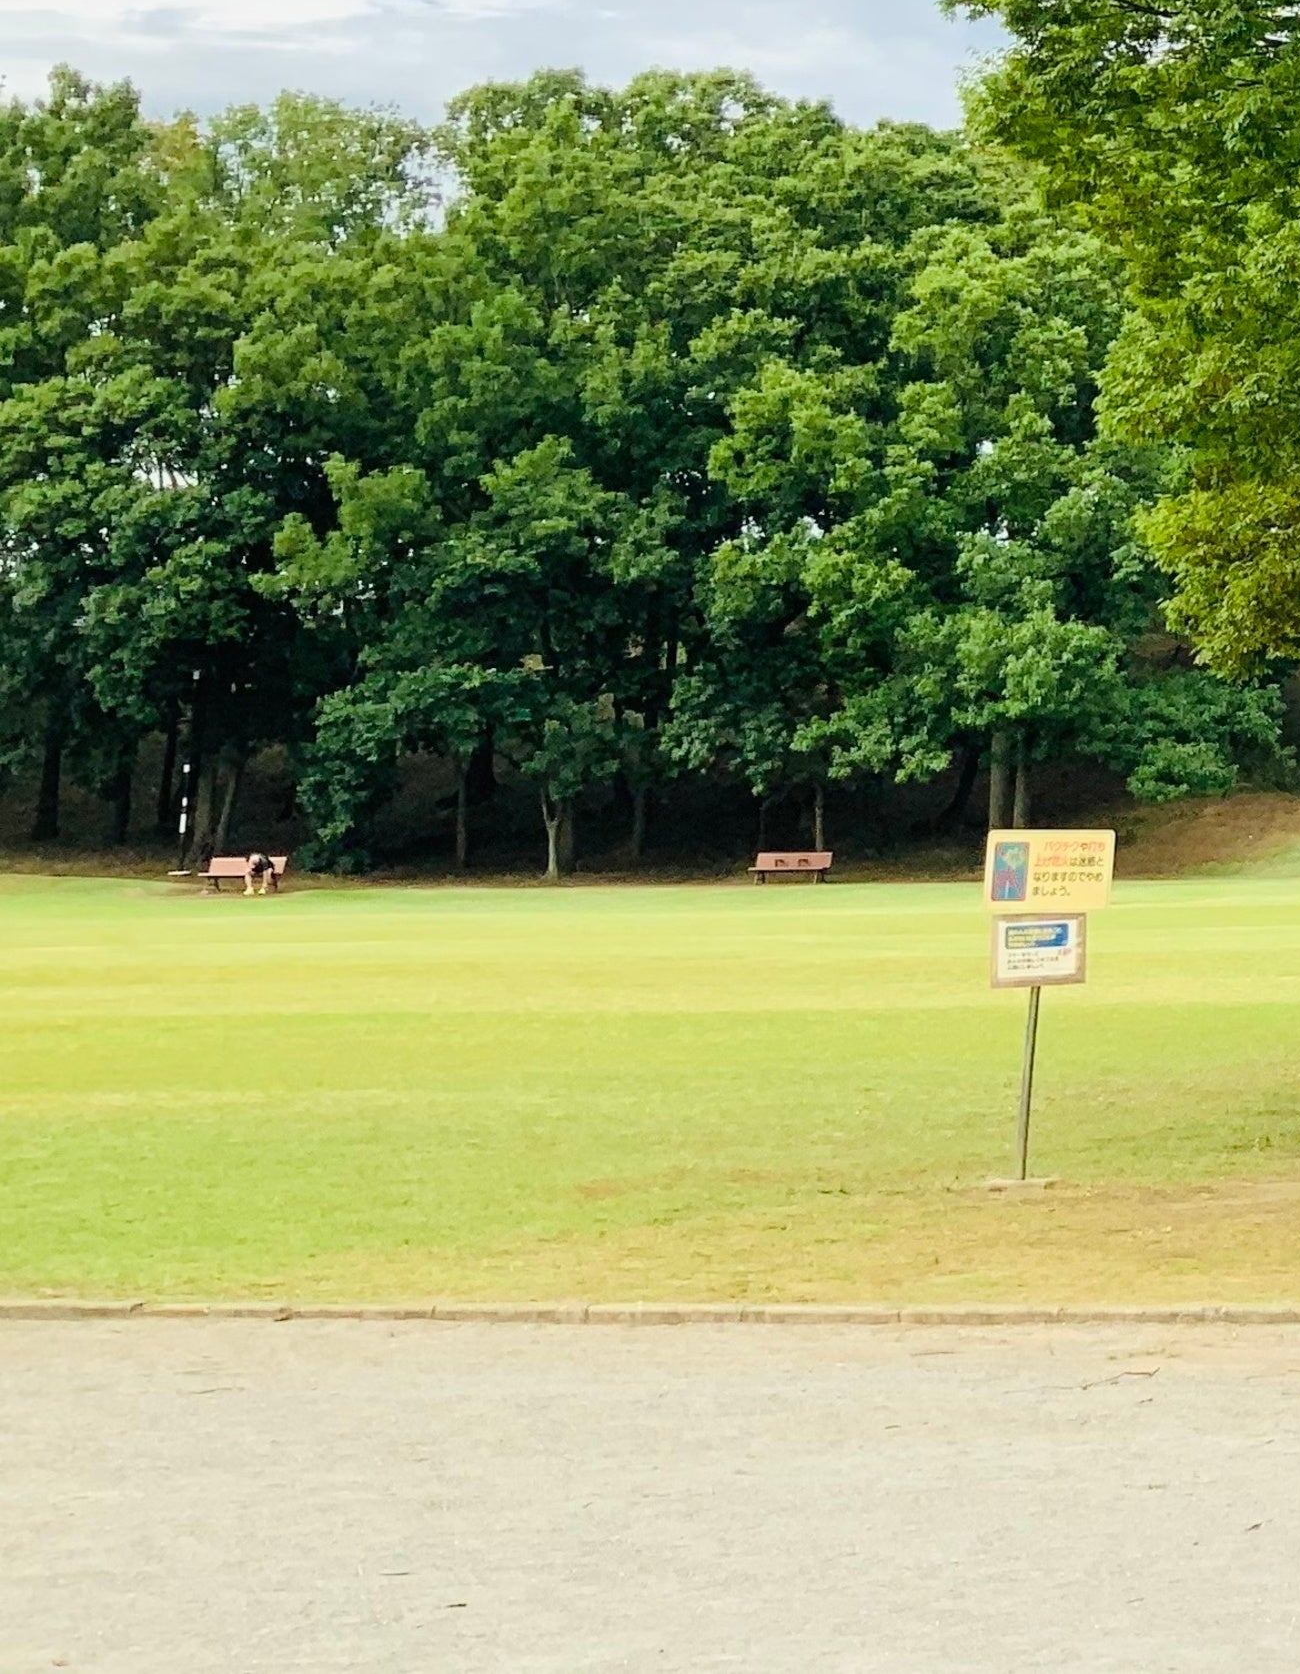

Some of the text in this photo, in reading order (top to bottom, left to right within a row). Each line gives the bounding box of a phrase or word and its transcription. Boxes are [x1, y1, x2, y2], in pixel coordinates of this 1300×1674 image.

[1033, 871, 1104, 883] なりますのでやめ
[1032, 885, 1071, 897] ましょう。
